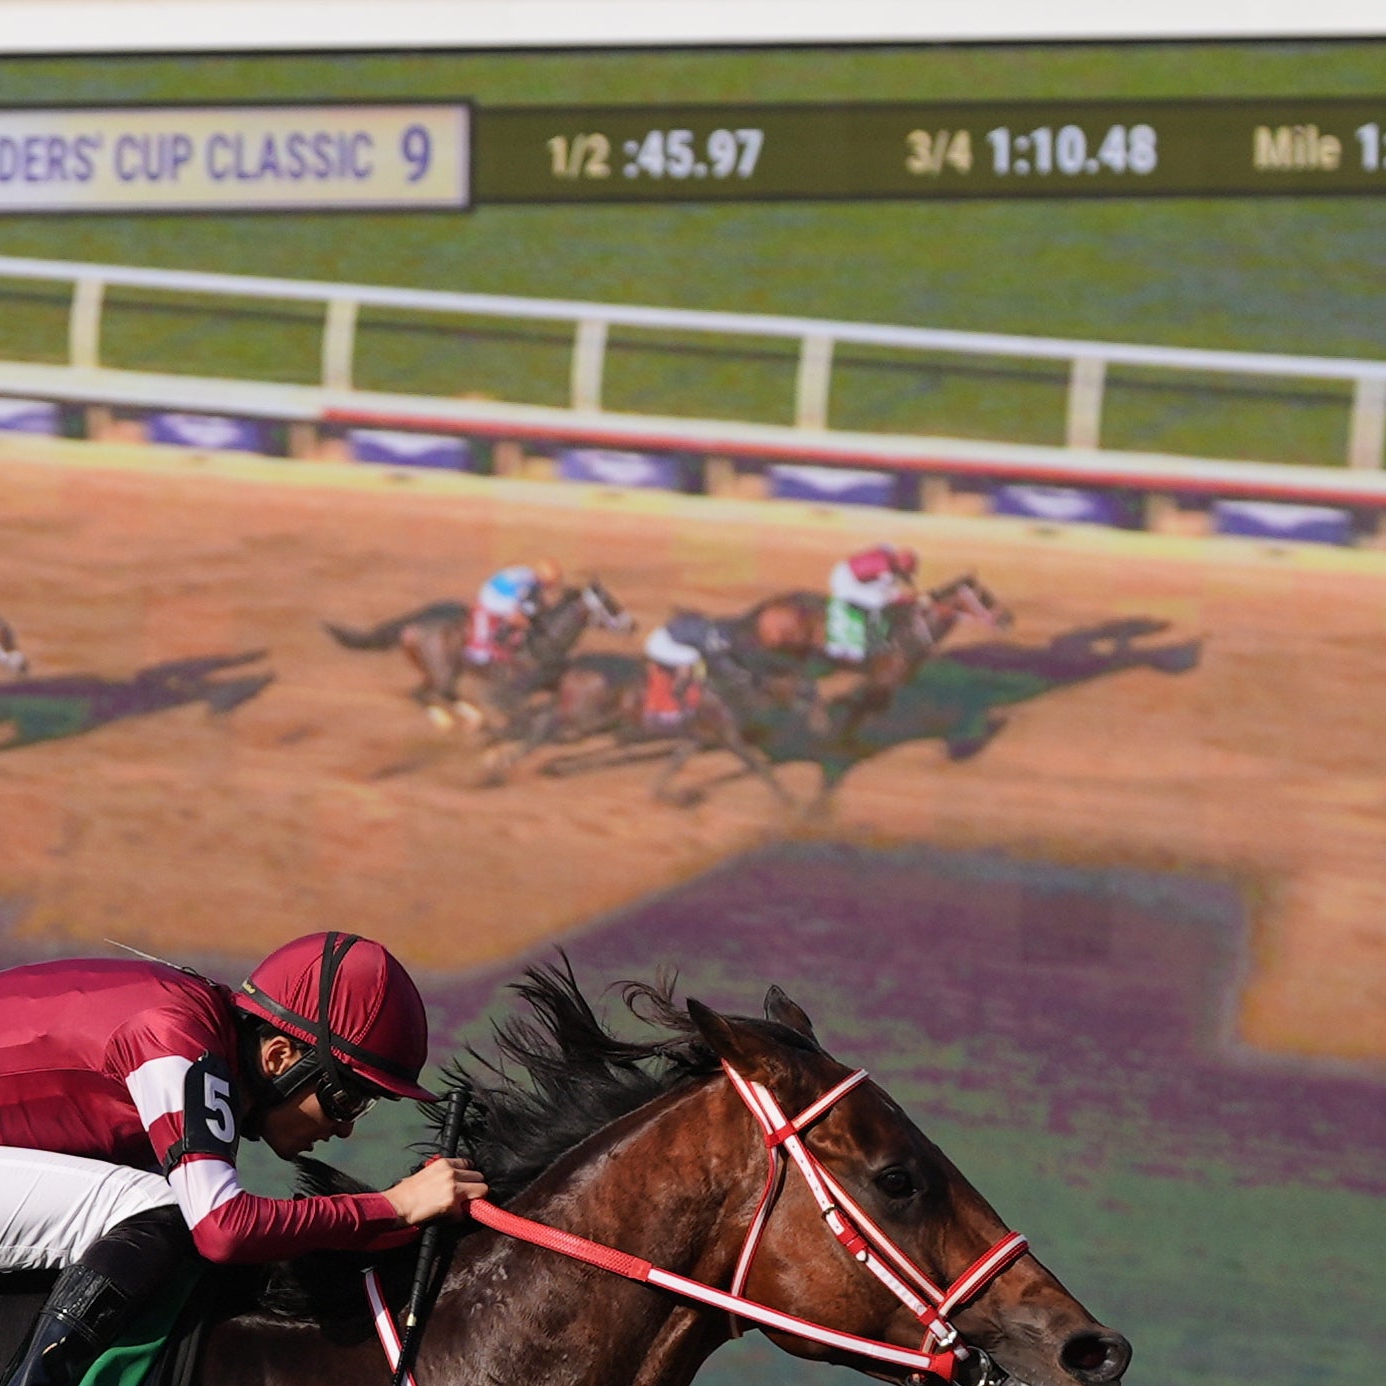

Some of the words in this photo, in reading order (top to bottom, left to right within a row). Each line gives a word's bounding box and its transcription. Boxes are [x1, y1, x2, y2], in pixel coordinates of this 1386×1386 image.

[114, 132, 192, 181] CUP
[206, 130, 374, 179] CLASSIC
[400, 123, 432, 183] 9
[547, 132, 611, 178] 1/2
[623, 128, 765, 178] :45.97
[905, 128, 973, 176] 3/4
[987, 124, 1158, 176] 1:10.48
[1252, 124, 1343, 172] Mile
[203, 1072, 236, 1143] 5
